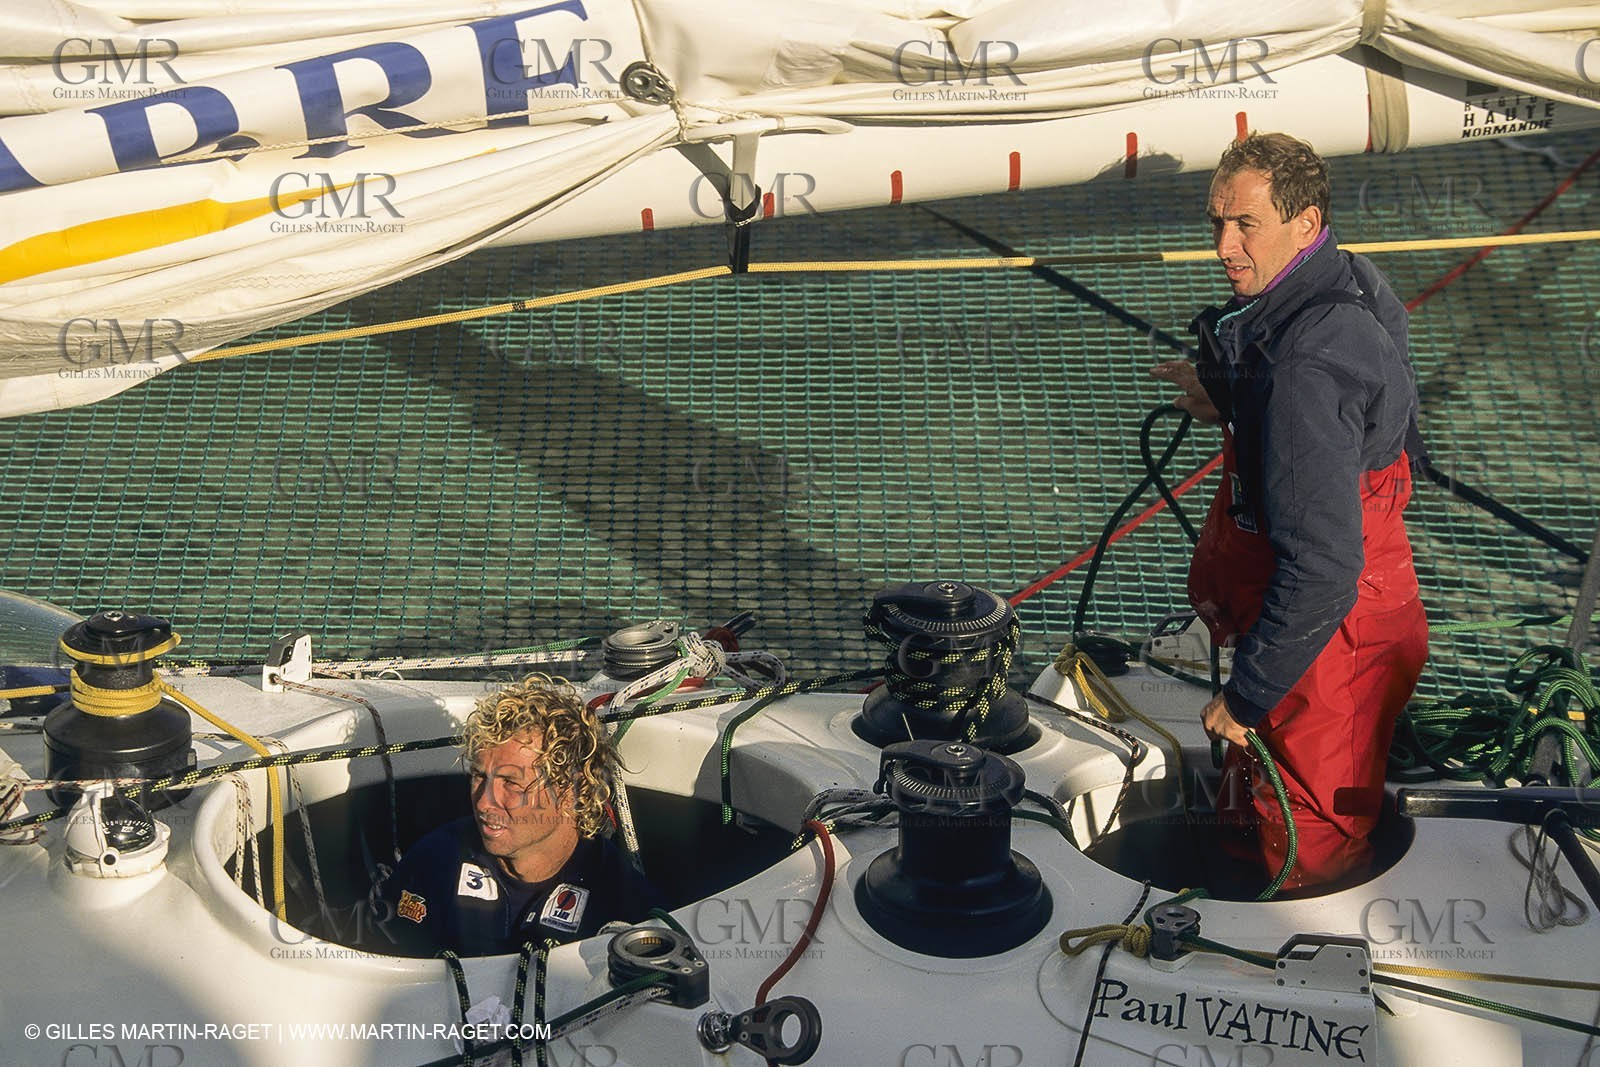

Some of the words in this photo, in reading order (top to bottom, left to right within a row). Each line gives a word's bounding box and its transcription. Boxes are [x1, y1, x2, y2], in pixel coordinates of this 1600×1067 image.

[1464, 103, 1555, 127] HAUTE
[1461, 119, 1553, 138] NORMANDIE
[466, 870, 484, 890] 3
[1094, 978, 1188, 1031] Paul
[1195, 997, 1370, 1063] VATINE
